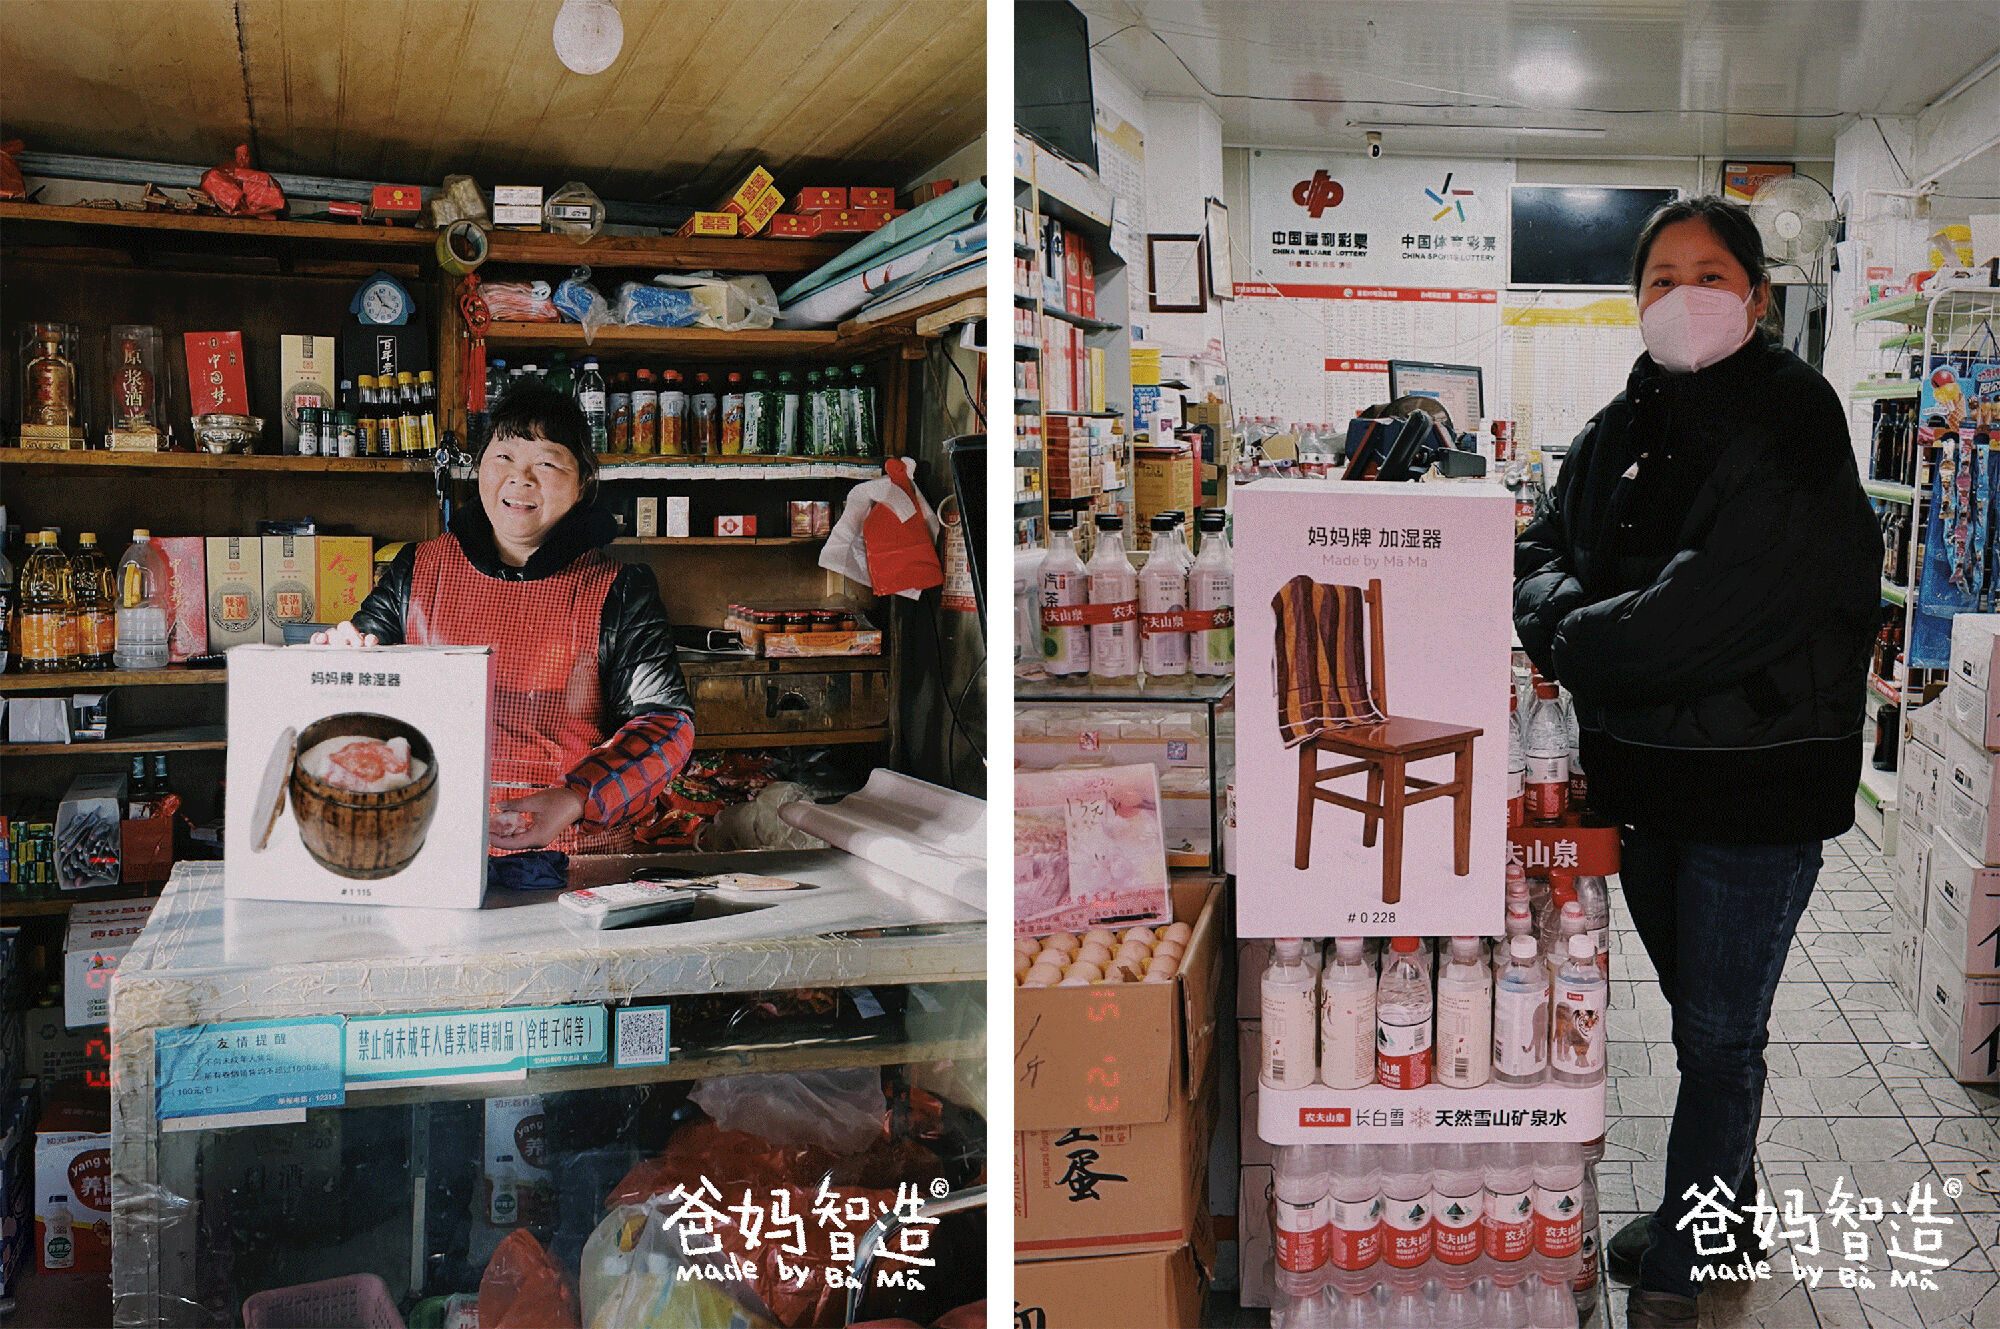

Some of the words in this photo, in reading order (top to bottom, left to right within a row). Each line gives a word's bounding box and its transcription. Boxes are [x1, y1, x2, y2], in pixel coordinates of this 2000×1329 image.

[1272, 231, 1368, 249] 中国福利彩票
[1401, 234, 1496, 251] 中国体育彩票
[1401, 252, 1426, 260] CHINA
[124, 348, 142, 408] 原浆酒
[1307, 526, 1372, 548] 妈妈牌
[1378, 528, 1443, 550] 加湿器
[1322, 554, 1360, 567] Made
[1363, 554, 1380, 569] by
[1044, 573, 1059, 608] 汽茶
[311, 671, 354, 686] 妈妈牌
[358, 671, 400, 687] 除湿器
[1347, 911, 1356, 924] #
[1360, 911, 1368, 924] 0
[1372, 911, 1396, 924] 228
[216, 1032, 287, 1050] 友情提醒
[1304, 1112, 1346, 1123] 农夫山泉
[1356, 1108, 1404, 1127] 长白雪
[1435, 1109, 1568, 1127] 天然雪山矿泉水
[71, 1156, 101, 1177] yang
